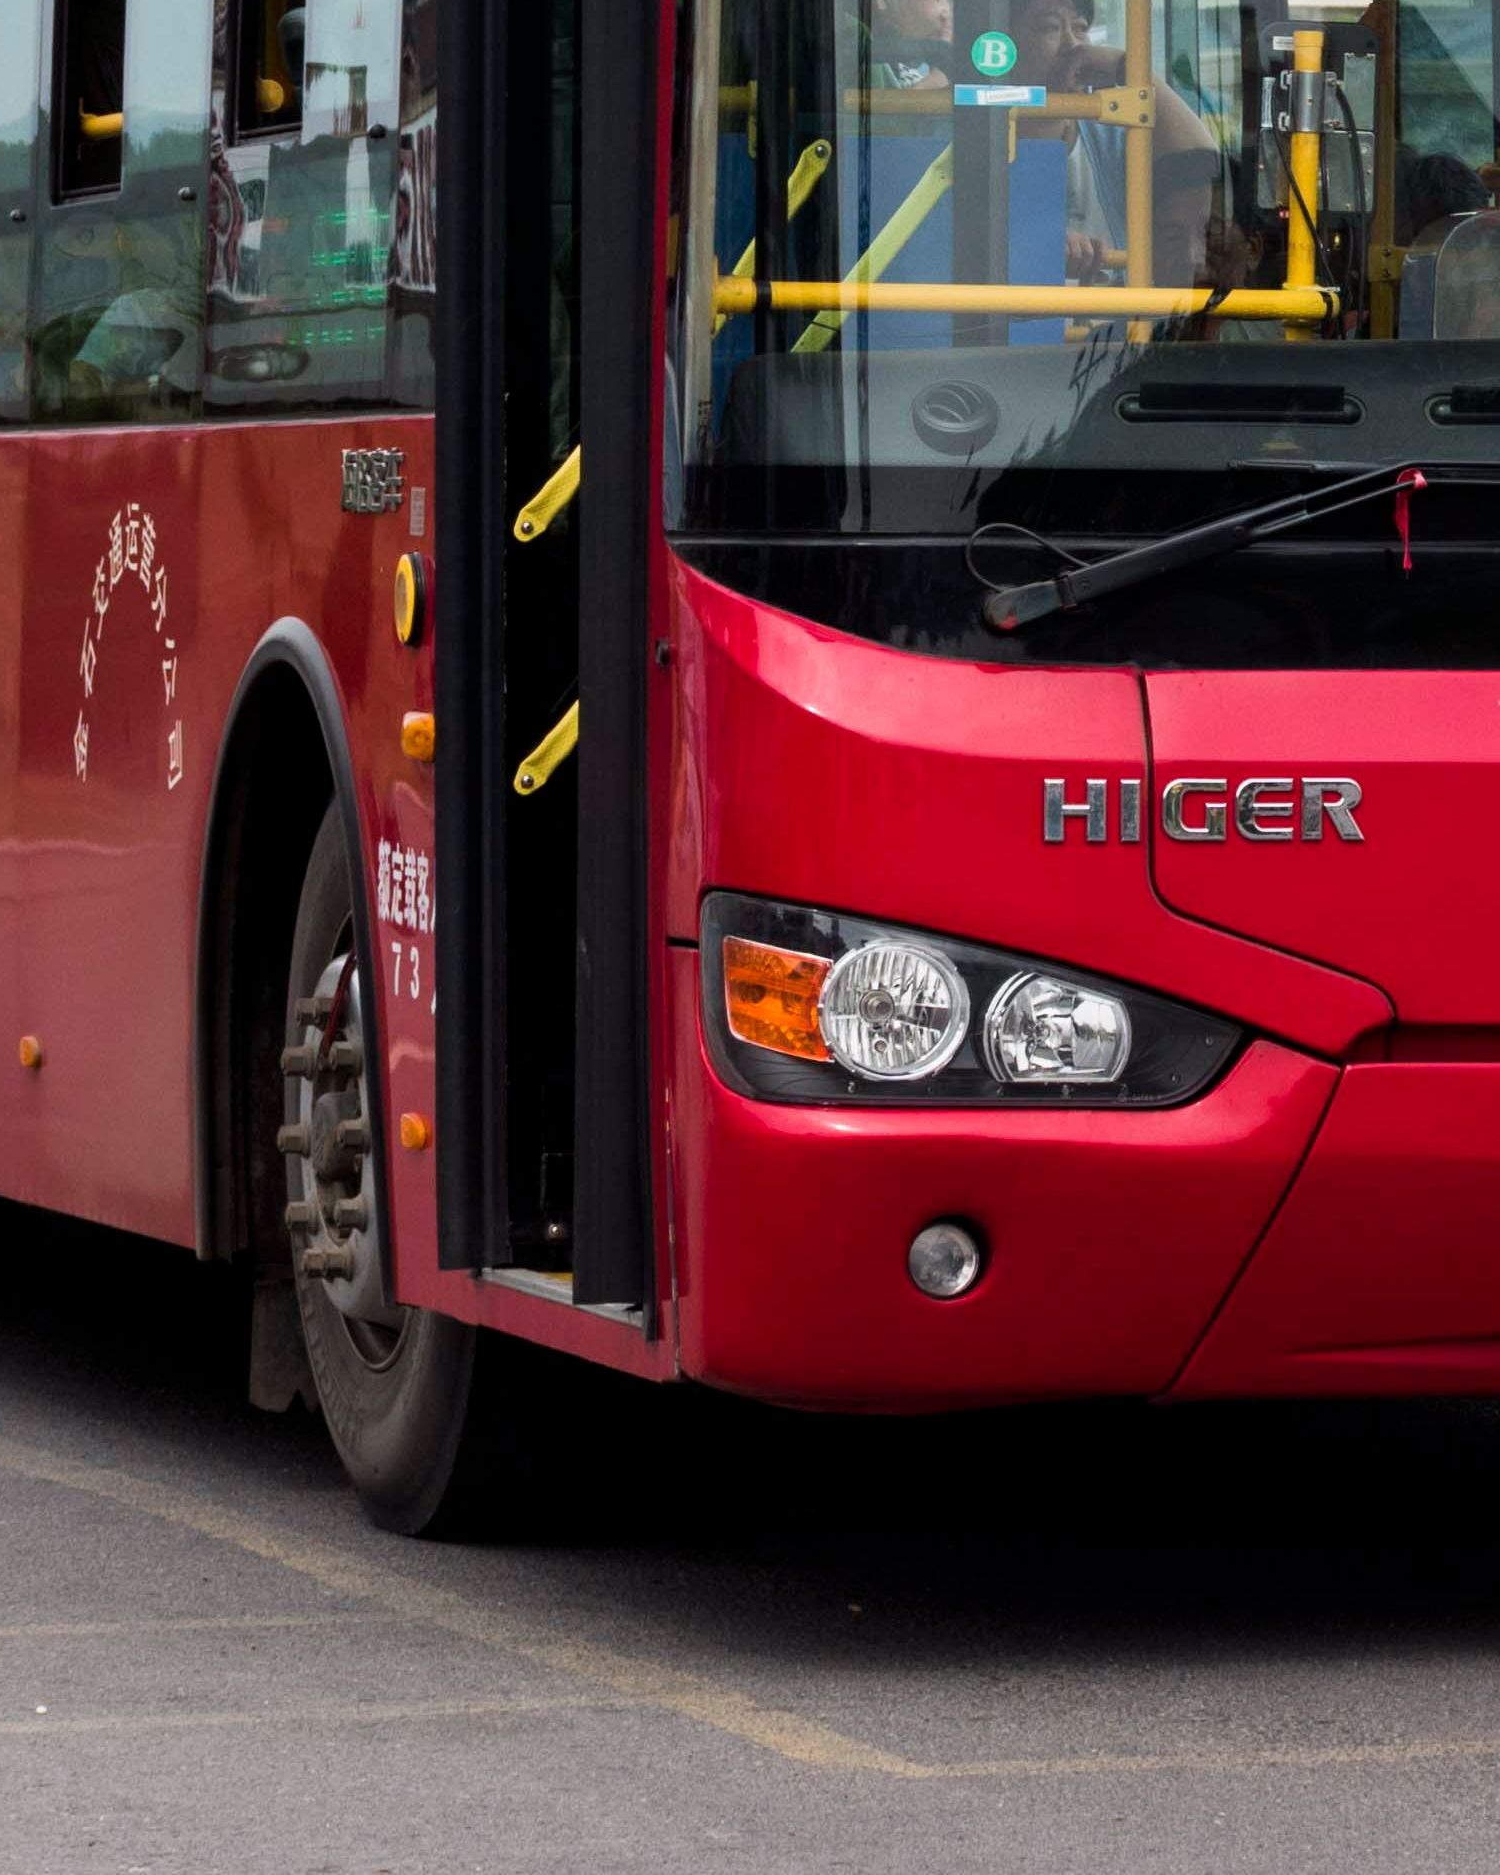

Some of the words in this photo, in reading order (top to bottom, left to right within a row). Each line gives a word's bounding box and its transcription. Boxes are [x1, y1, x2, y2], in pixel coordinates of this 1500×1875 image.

[979, 38, 1008, 68] B
[1042, 776, 1366, 843] HIGER
[377, 836, 436, 935] 额定载客
